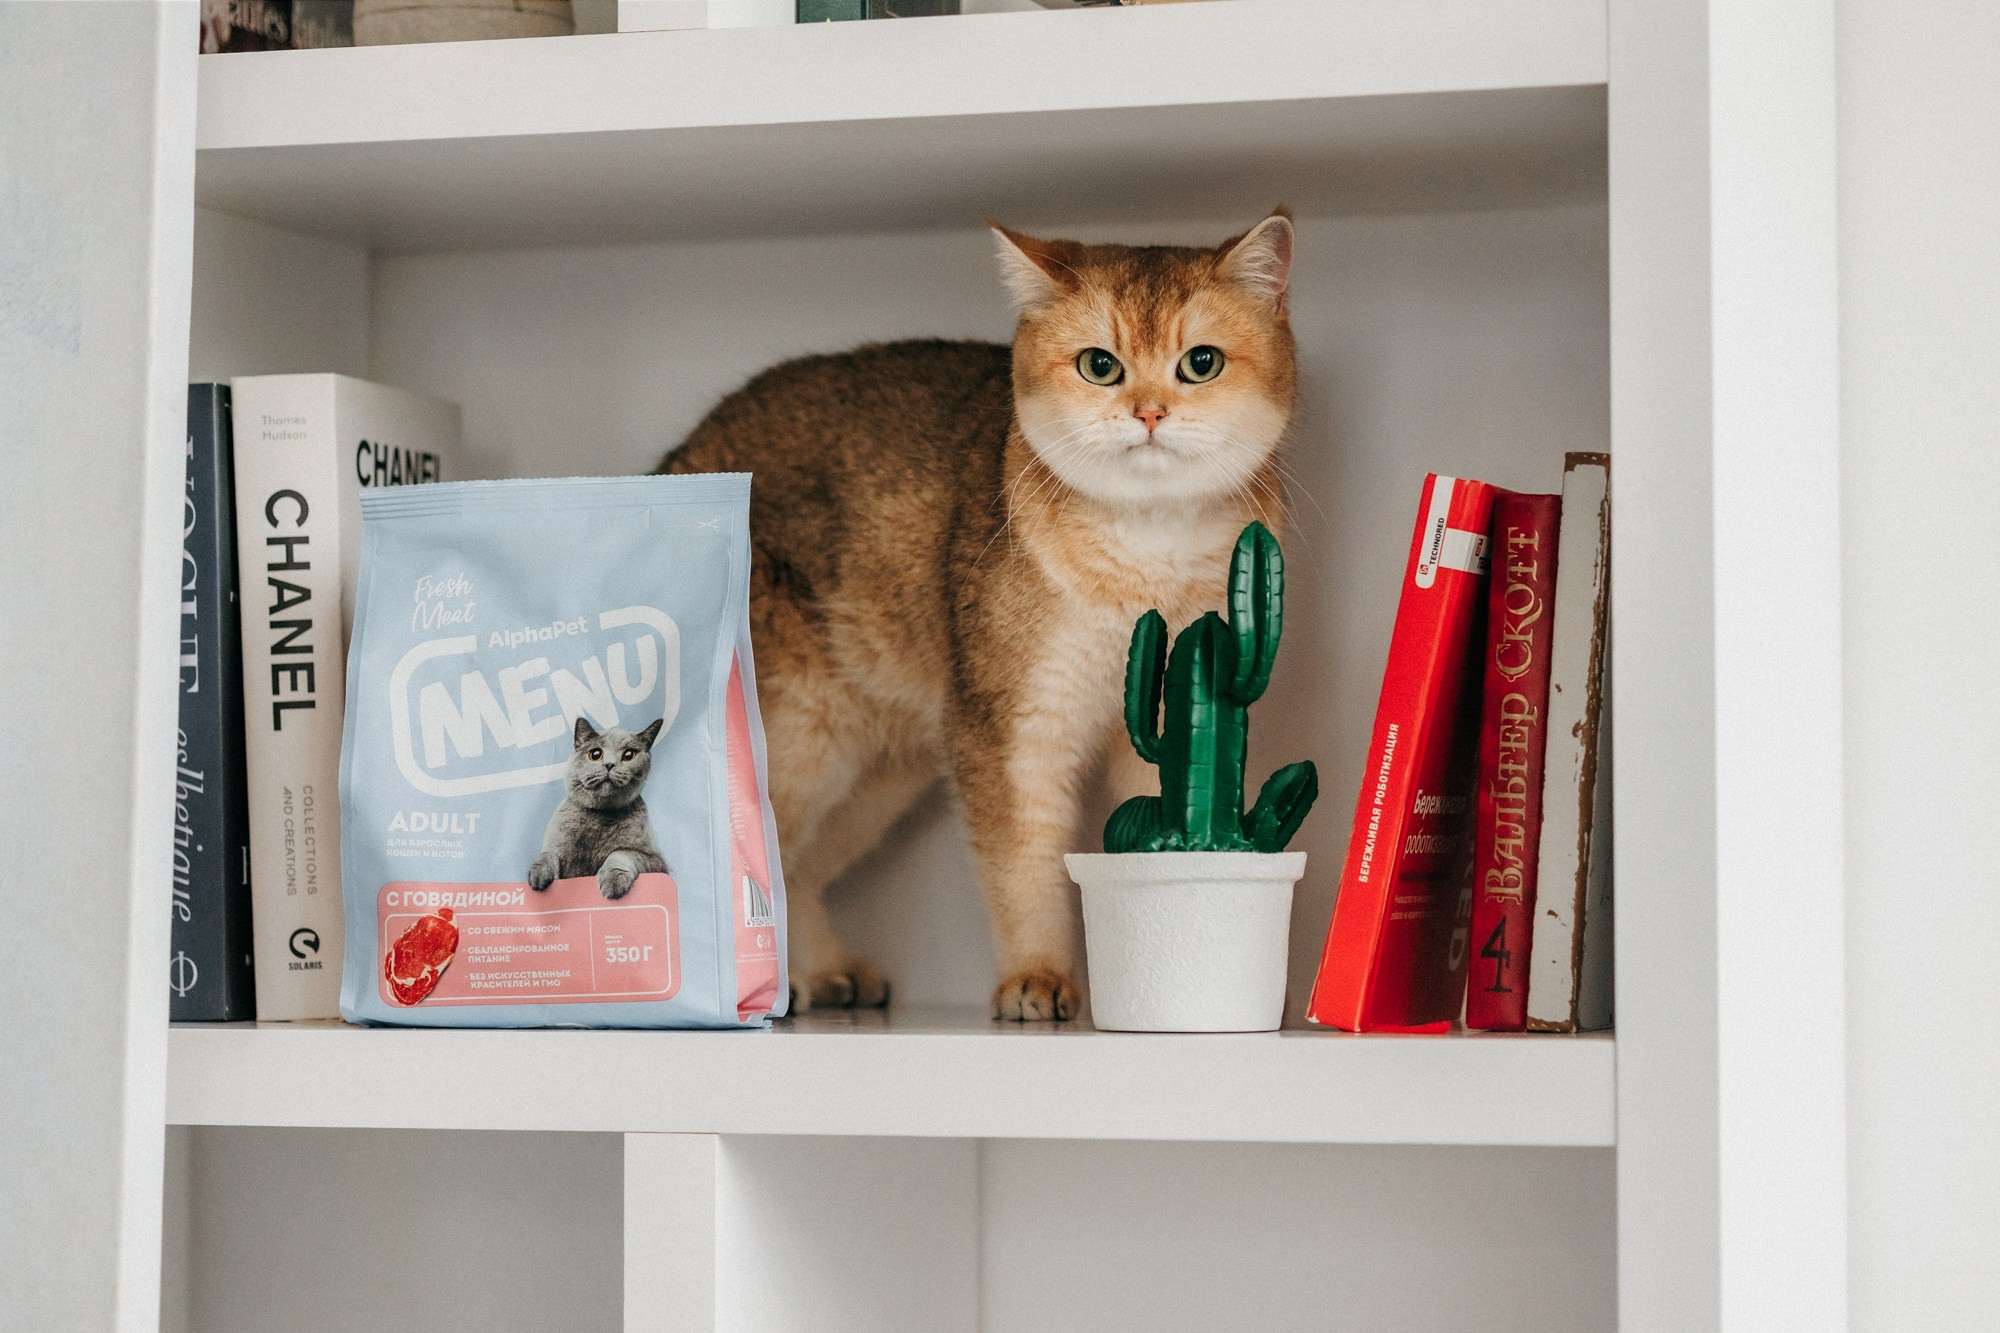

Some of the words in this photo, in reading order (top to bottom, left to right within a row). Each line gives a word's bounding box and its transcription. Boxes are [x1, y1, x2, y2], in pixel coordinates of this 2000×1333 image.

[262, 429, 307, 442] Hudson
[1429, 517, 1445, 566] TECHNORED
[414, 571, 474, 604] Fresh
[265, 489, 316, 732] CHANEL
[411, 598, 477, 633] Meat
[487, 615, 589, 650] AlphaPet
[419, 633, 658, 769] MENU
[282, 785, 294, 815] AND
[1358, 807, 1382, 883] БЕРЕЖЛИВАЯ
[1374, 723, 1400, 806] РОБОТИЗАЦИЯ
[387, 810, 481, 834] ADULT
[303, 785, 318, 896] COLLECTIONS
[283, 818, 297, 897] CREATIONS
[386, 890, 400, 907] С
[403, 887, 525, 908] ГОВЯДИНОЙ
[467, 926, 481, 935] СО
[483, 926, 524, 935] СВЕЖИМ
[526, 924, 561, 934] МЯСОМ
[467, 943, 570, 955] СБАЛАНСИРОВАННОЕ
[468, 955, 511, 963] ПИТАНИЕ
[606, 946, 640, 963] 350
[1480, 915, 1513, 993] 4
[288, 961, 323, 971] SOLARIS
[469, 973, 486, 981] БЕЗ
[487, 970, 571, 980] ИСКУССТВЕННЫХ
[470, 979, 531, 989] КРАСИТЕЛЕЙ
[541, 979, 561, 987] ГМО
